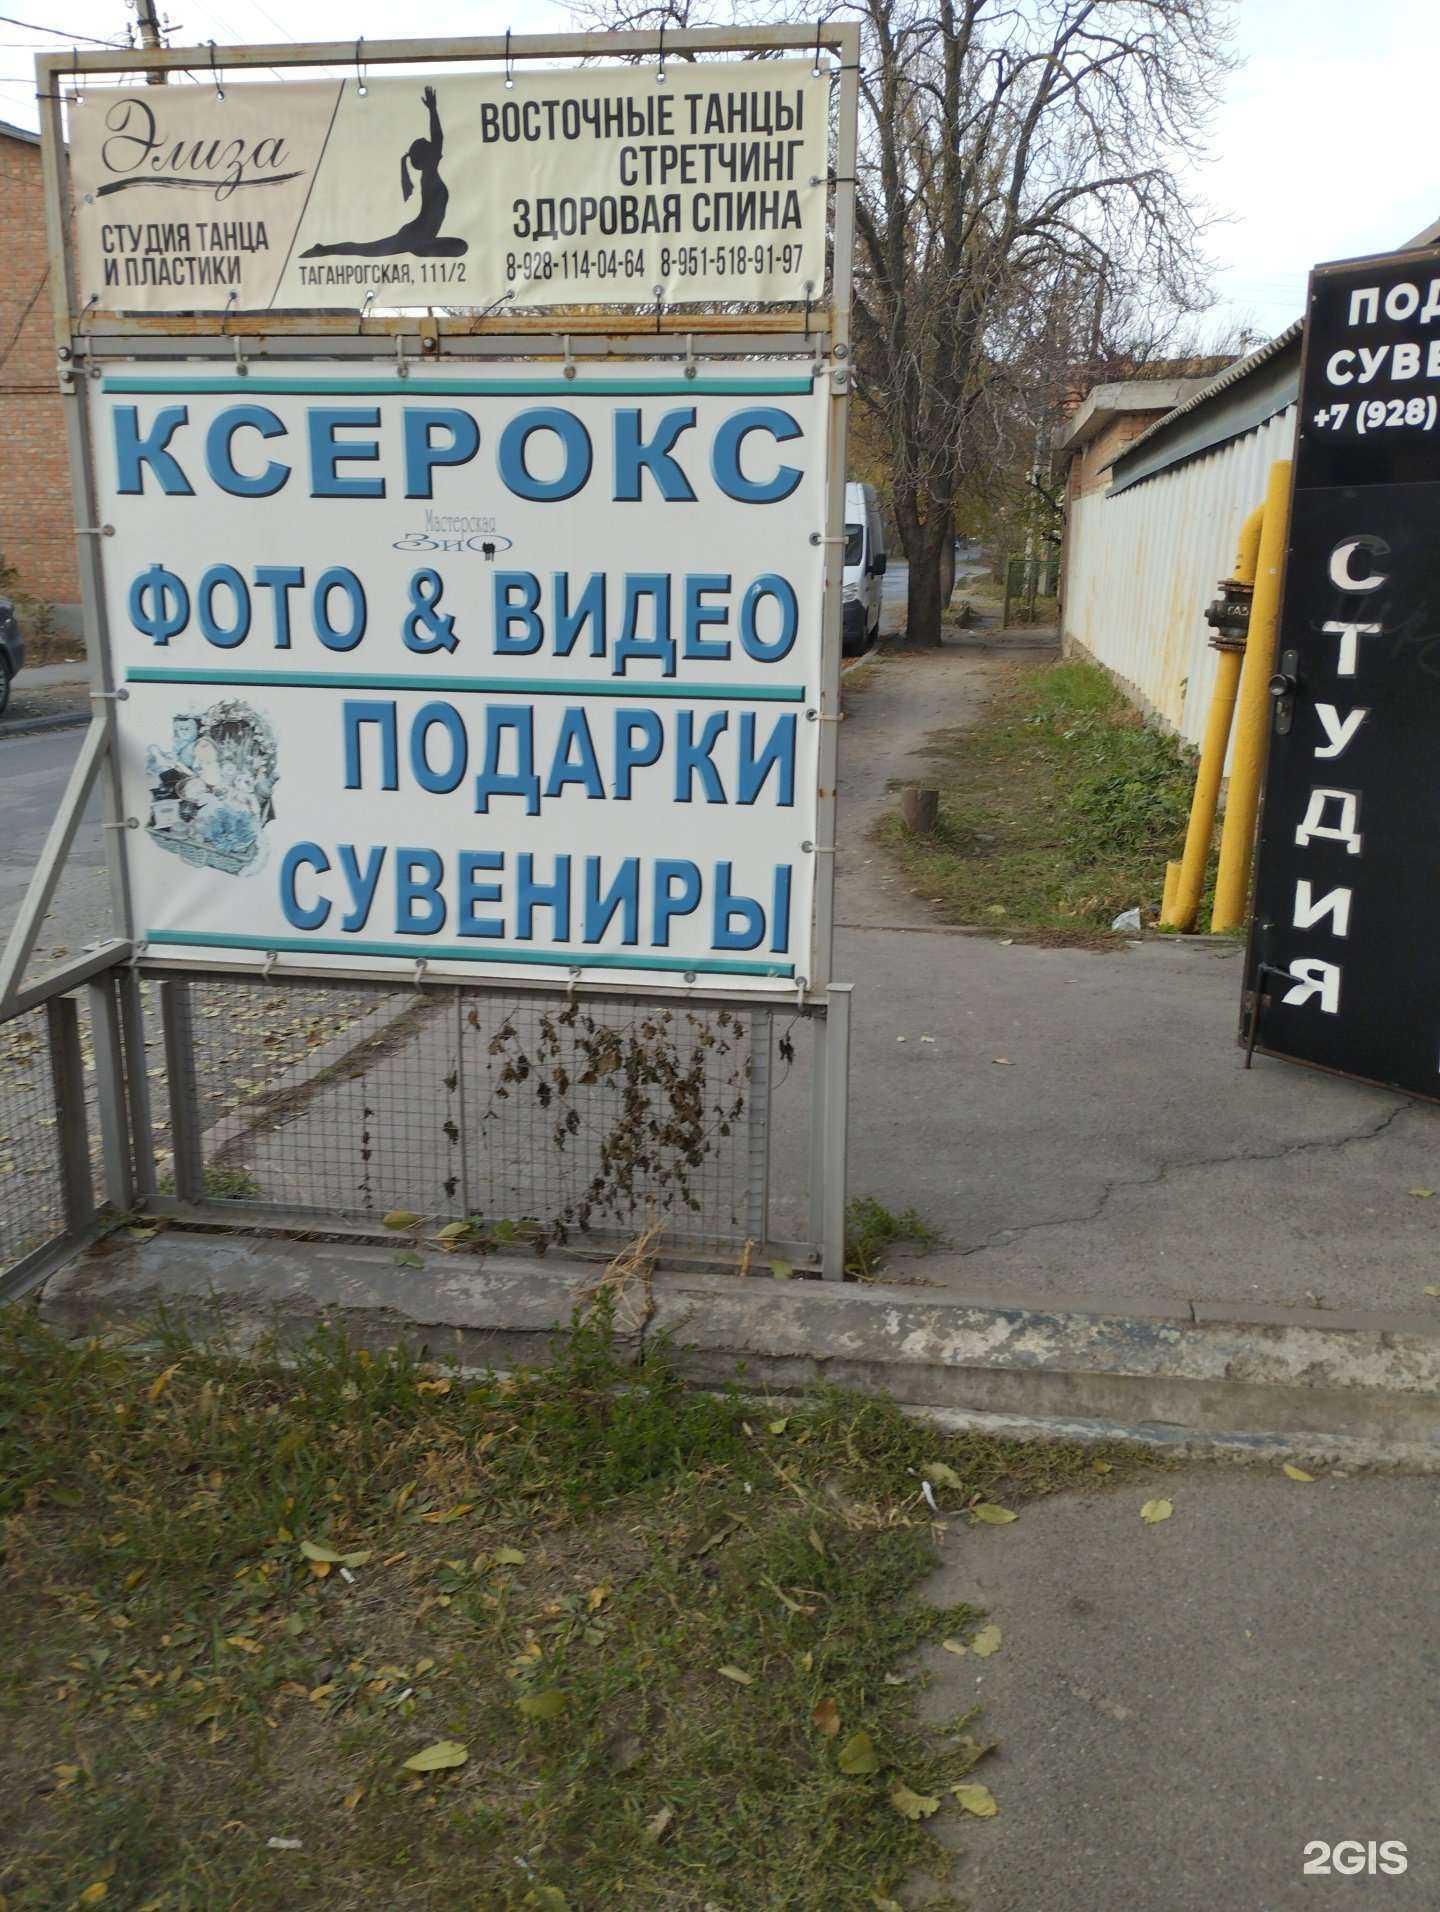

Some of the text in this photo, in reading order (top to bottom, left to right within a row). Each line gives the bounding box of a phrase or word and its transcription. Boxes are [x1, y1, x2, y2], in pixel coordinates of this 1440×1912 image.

[480, 90, 804, 143] ВОСТОЧНЫЕ ТАНЦЫ
[102, 99, 289, 201] Элиза
[620, 140, 804, 187] СТРЕТЧИНГ
[101, 221, 269, 256] СТУДИЯ ТАНЦА
[513, 189, 802, 242] ЗДОРОВАЯ СПИНА
[104, 256, 242, 287] И ПЛАСТИКИ
[299, 262, 467, 286] ТАГАНРОГСКАЯ, 111/2
[506, 244, 803, 282] 8-928-114-04-64 8-951-518-91-97
[1313, 395, 1438, 434] +7 (928)
[110, 403, 805, 505] КСЕРОКС
[127, 562, 800, 678] ФОТО & ВИДЕО
[1227, 606, 1249, 616] ГАЗ
[341, 698, 798, 816] ПОДАРКИ
[1282, 535, 1390, 1015] СТУДИЯ
[278, 839, 793, 955] СУВЕНИРЫ
